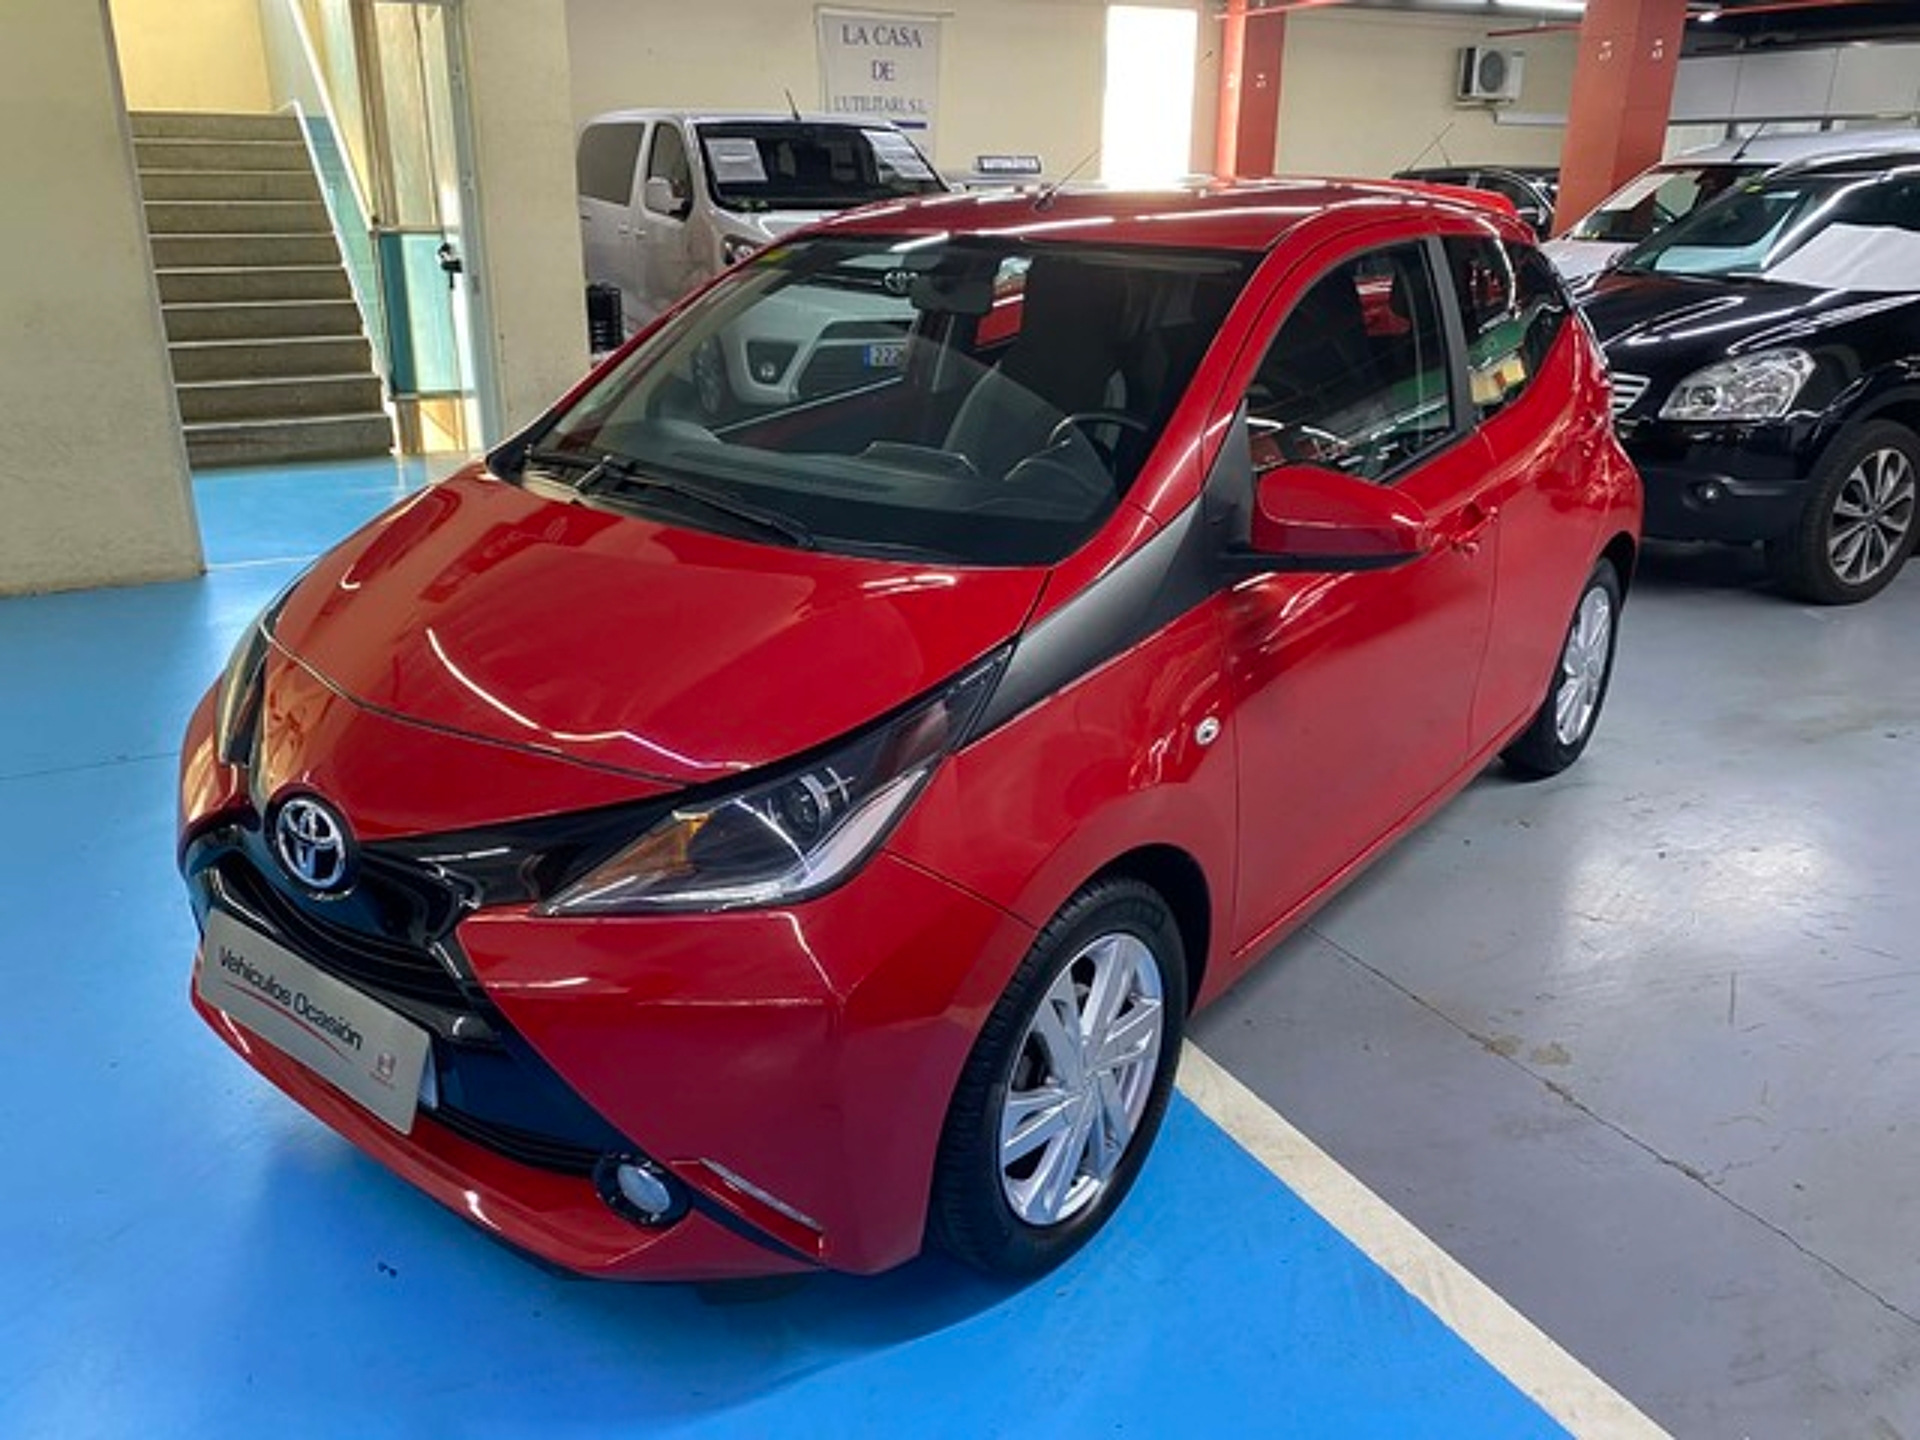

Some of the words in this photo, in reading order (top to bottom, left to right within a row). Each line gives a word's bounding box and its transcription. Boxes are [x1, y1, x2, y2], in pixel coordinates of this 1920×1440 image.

[842, 24, 868, 45] LA
[872, 26, 922, 48] CASA
[871, 60, 895, 81] DE
[294, 992, 363, 1051] Ocasión
